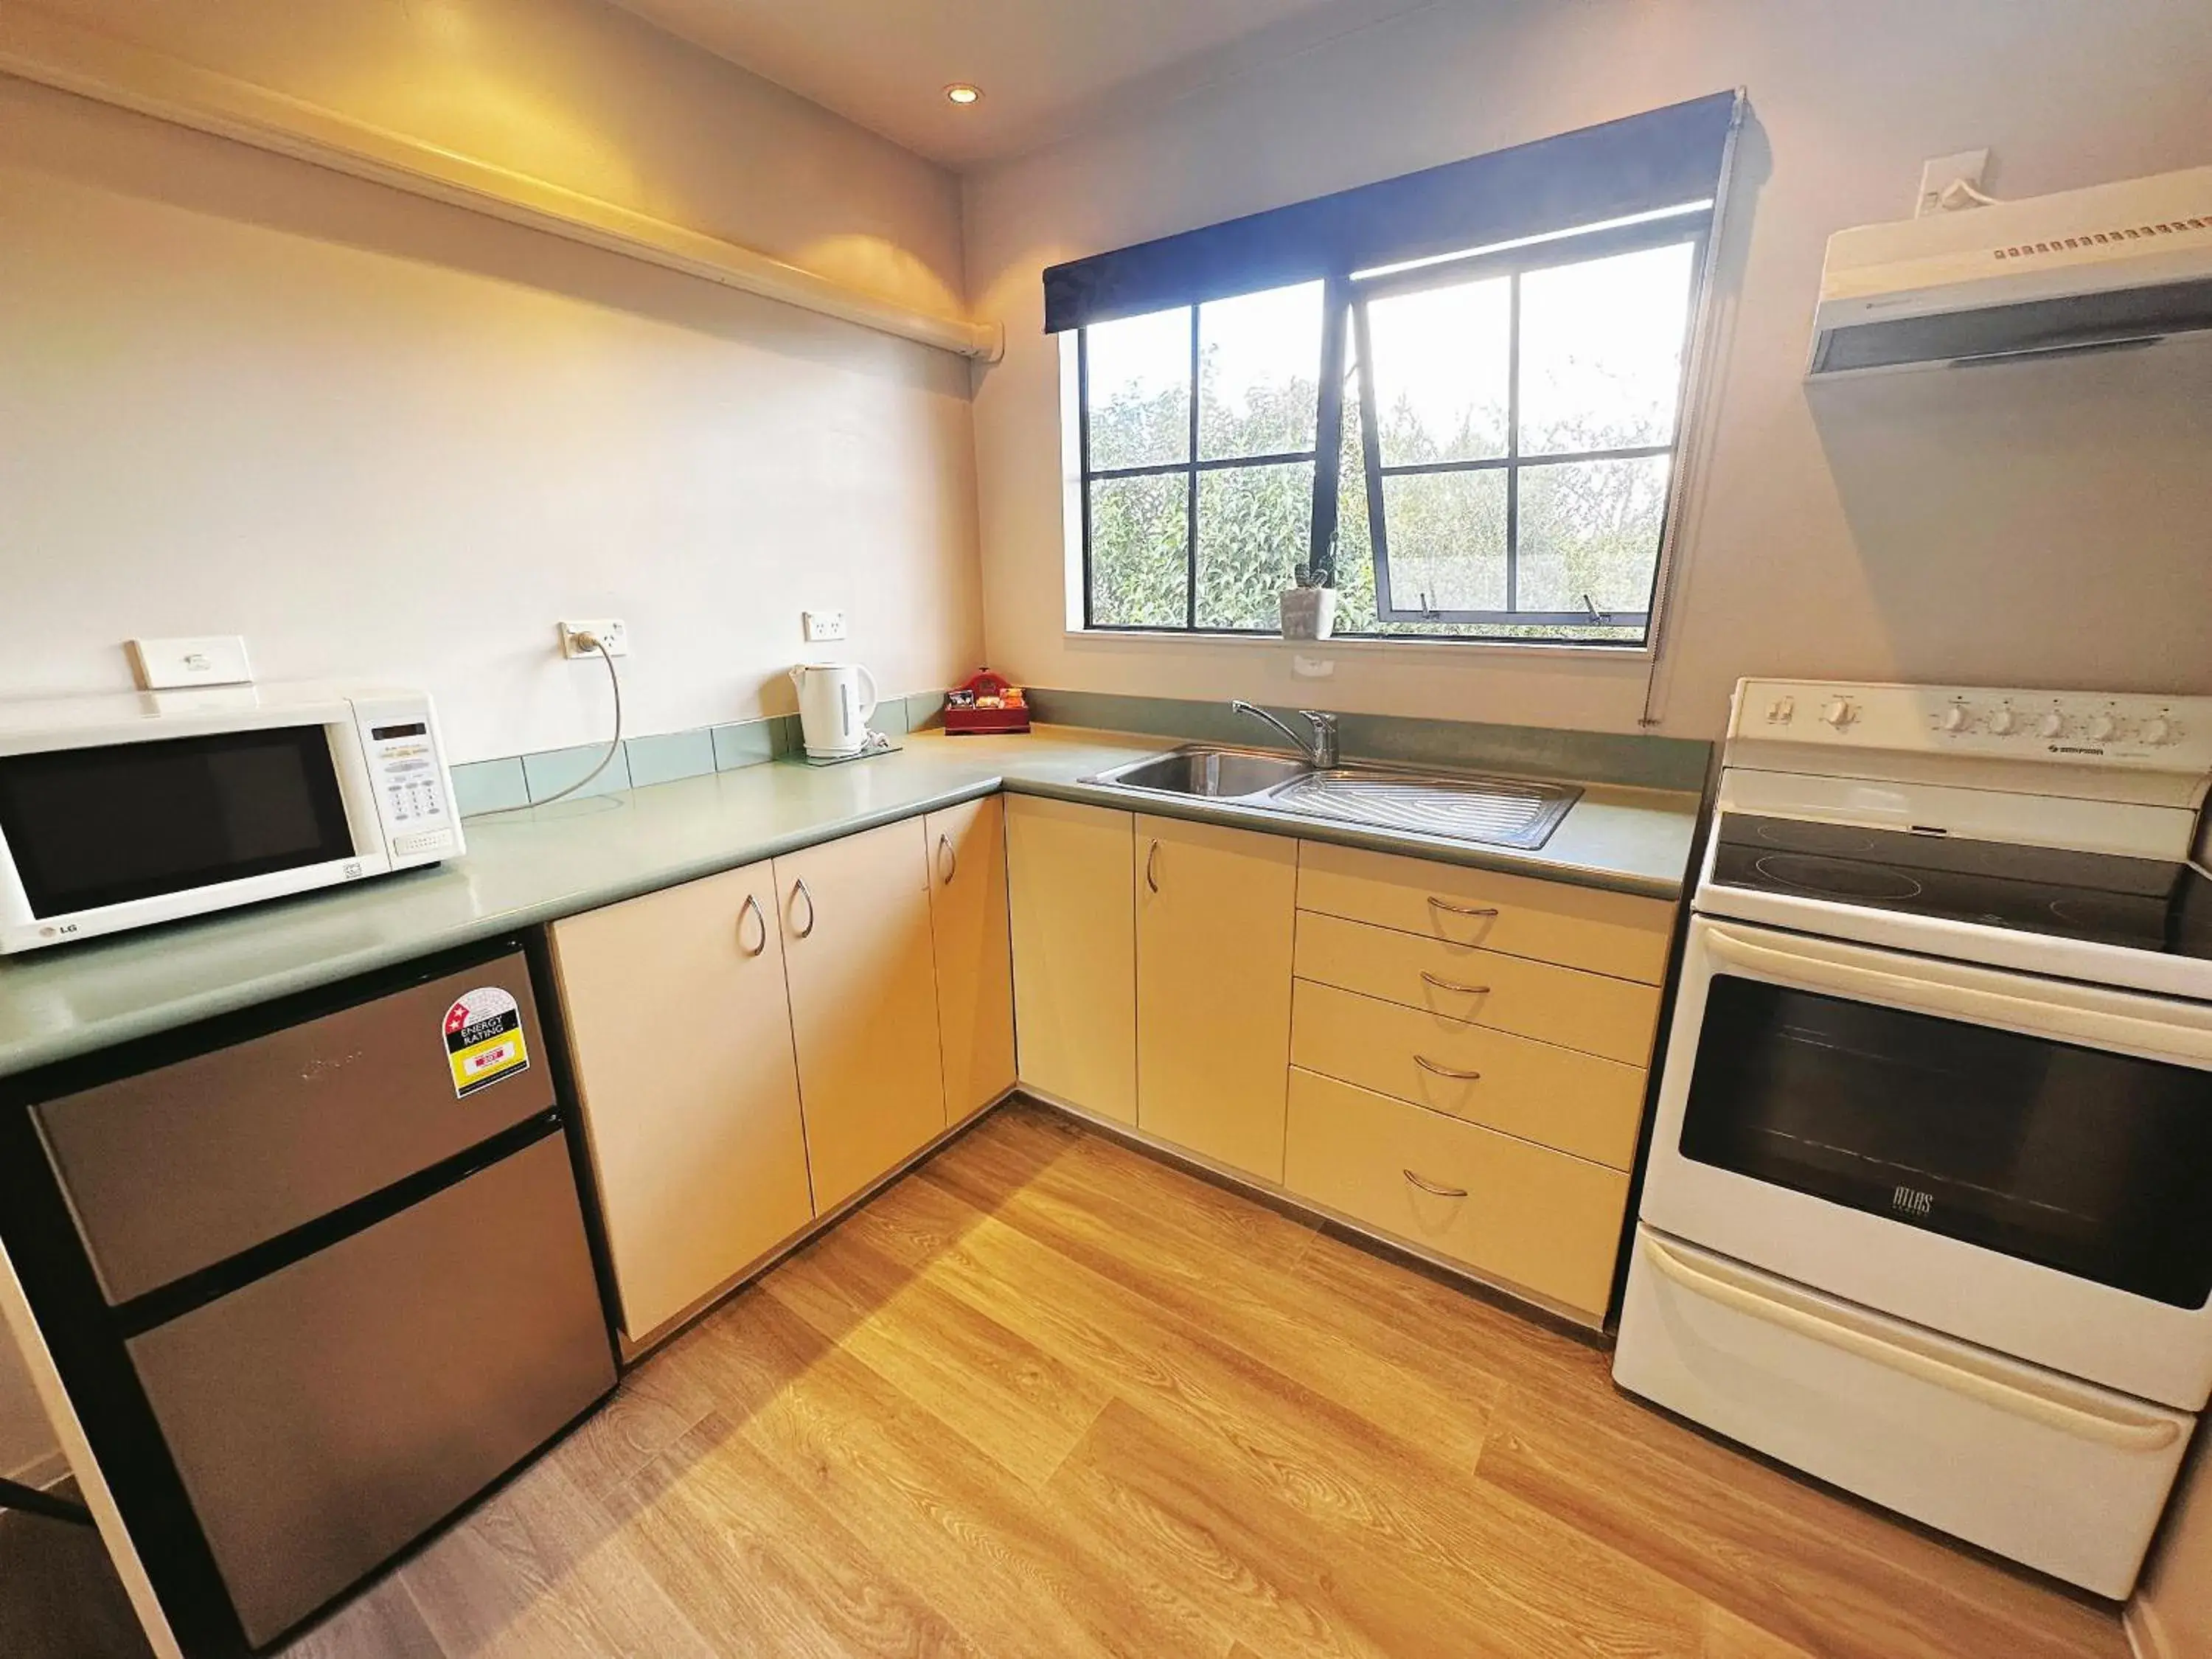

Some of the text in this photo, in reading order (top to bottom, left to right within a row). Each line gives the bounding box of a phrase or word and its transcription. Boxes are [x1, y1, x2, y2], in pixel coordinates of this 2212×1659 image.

[60, 924, 77, 933] LG
[461, 1015, 502, 1037] ENERGY
[464, 1024, 504, 1046] RATING
[1893, 1186, 1933, 1213] ATLAS
